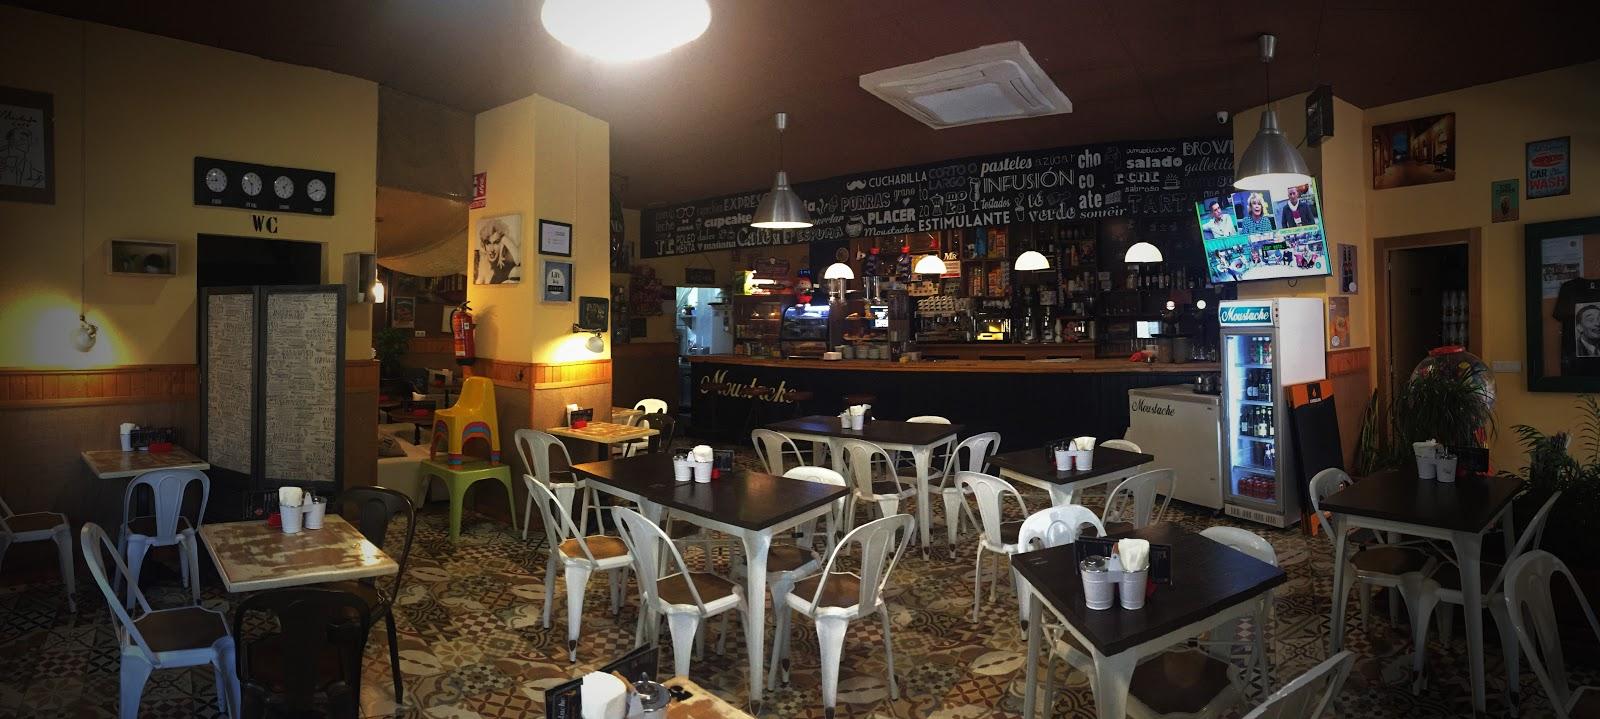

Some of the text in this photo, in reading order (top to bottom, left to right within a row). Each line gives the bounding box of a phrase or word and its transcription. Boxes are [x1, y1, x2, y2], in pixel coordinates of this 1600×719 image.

[981, 155, 1032, 178] pasteles
[1078, 148, 1102, 169] cho
[1126, 155, 1183, 169] salado
[868, 170, 927, 187] CUCHARILLA
[983, 166, 1075, 194] INFUSIÓN
[1530, 168, 1547, 179] CAR
[1528, 176, 1566, 190] WASH
[841, 192, 891, 213] PORRAS
[1078, 189, 1103, 209] ate
[704, 213, 753, 229] cupcake
[867, 207, 916, 225] PLACER
[917, 210, 1011, 233] ESTIMULANTE
[1028, 203, 1077, 223] verde
[252, 215, 278, 234] WC
[864, 223, 917, 238] Moustache
[1221, 308, 1269, 323] Moustache
[1131, 399, 1176, 417] Moustache
